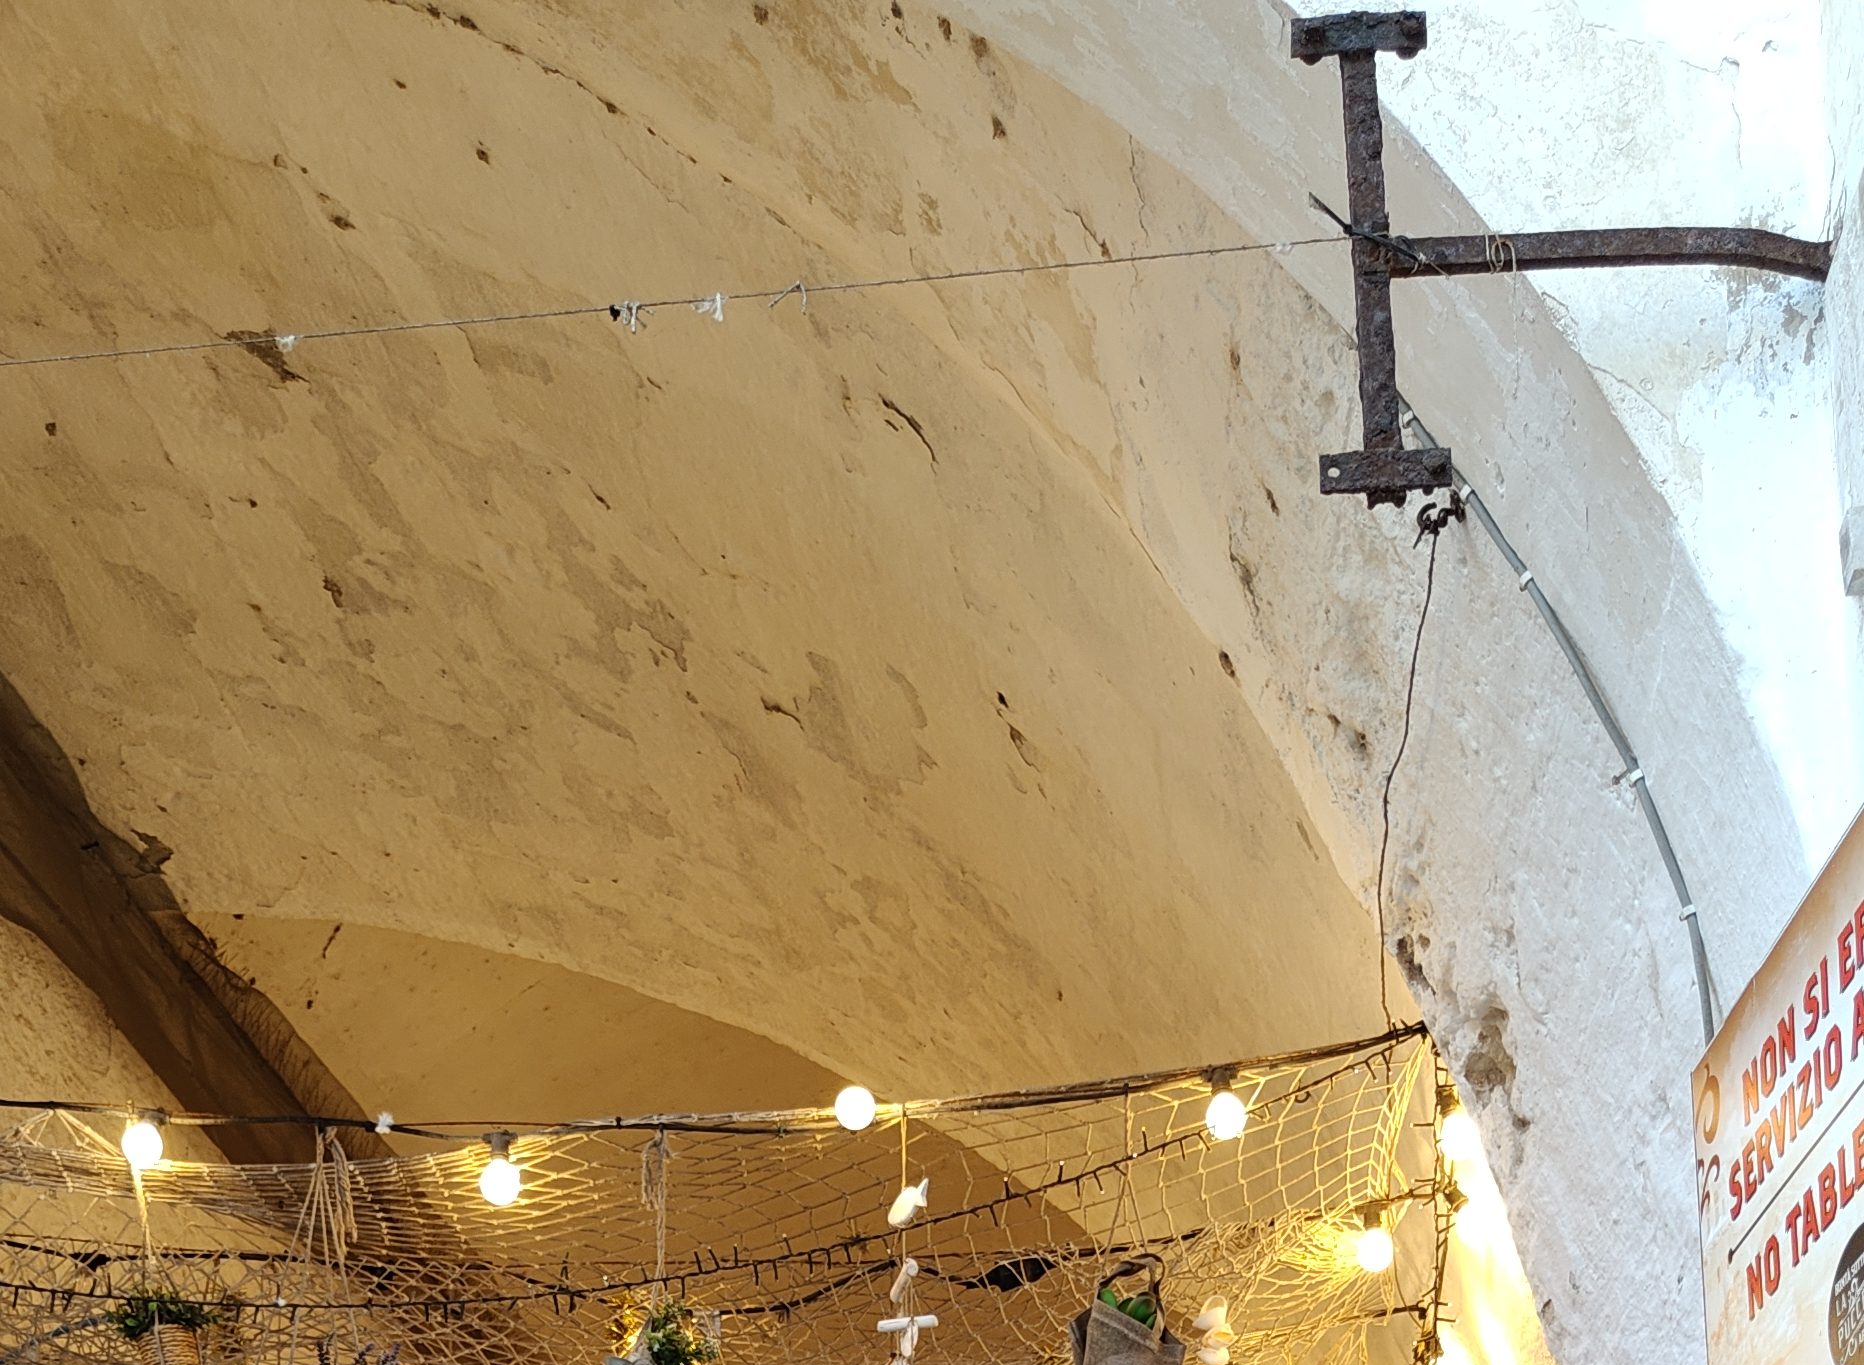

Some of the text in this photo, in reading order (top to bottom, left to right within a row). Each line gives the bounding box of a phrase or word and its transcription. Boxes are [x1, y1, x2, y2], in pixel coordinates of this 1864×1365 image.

[1728, 1023, 1843, 1221] SERVIZIO
[1741, 1003, 1797, 1126] NON
[1803, 955, 1830, 1041] SI
[1745, 1234, 1781, 1322] NO
